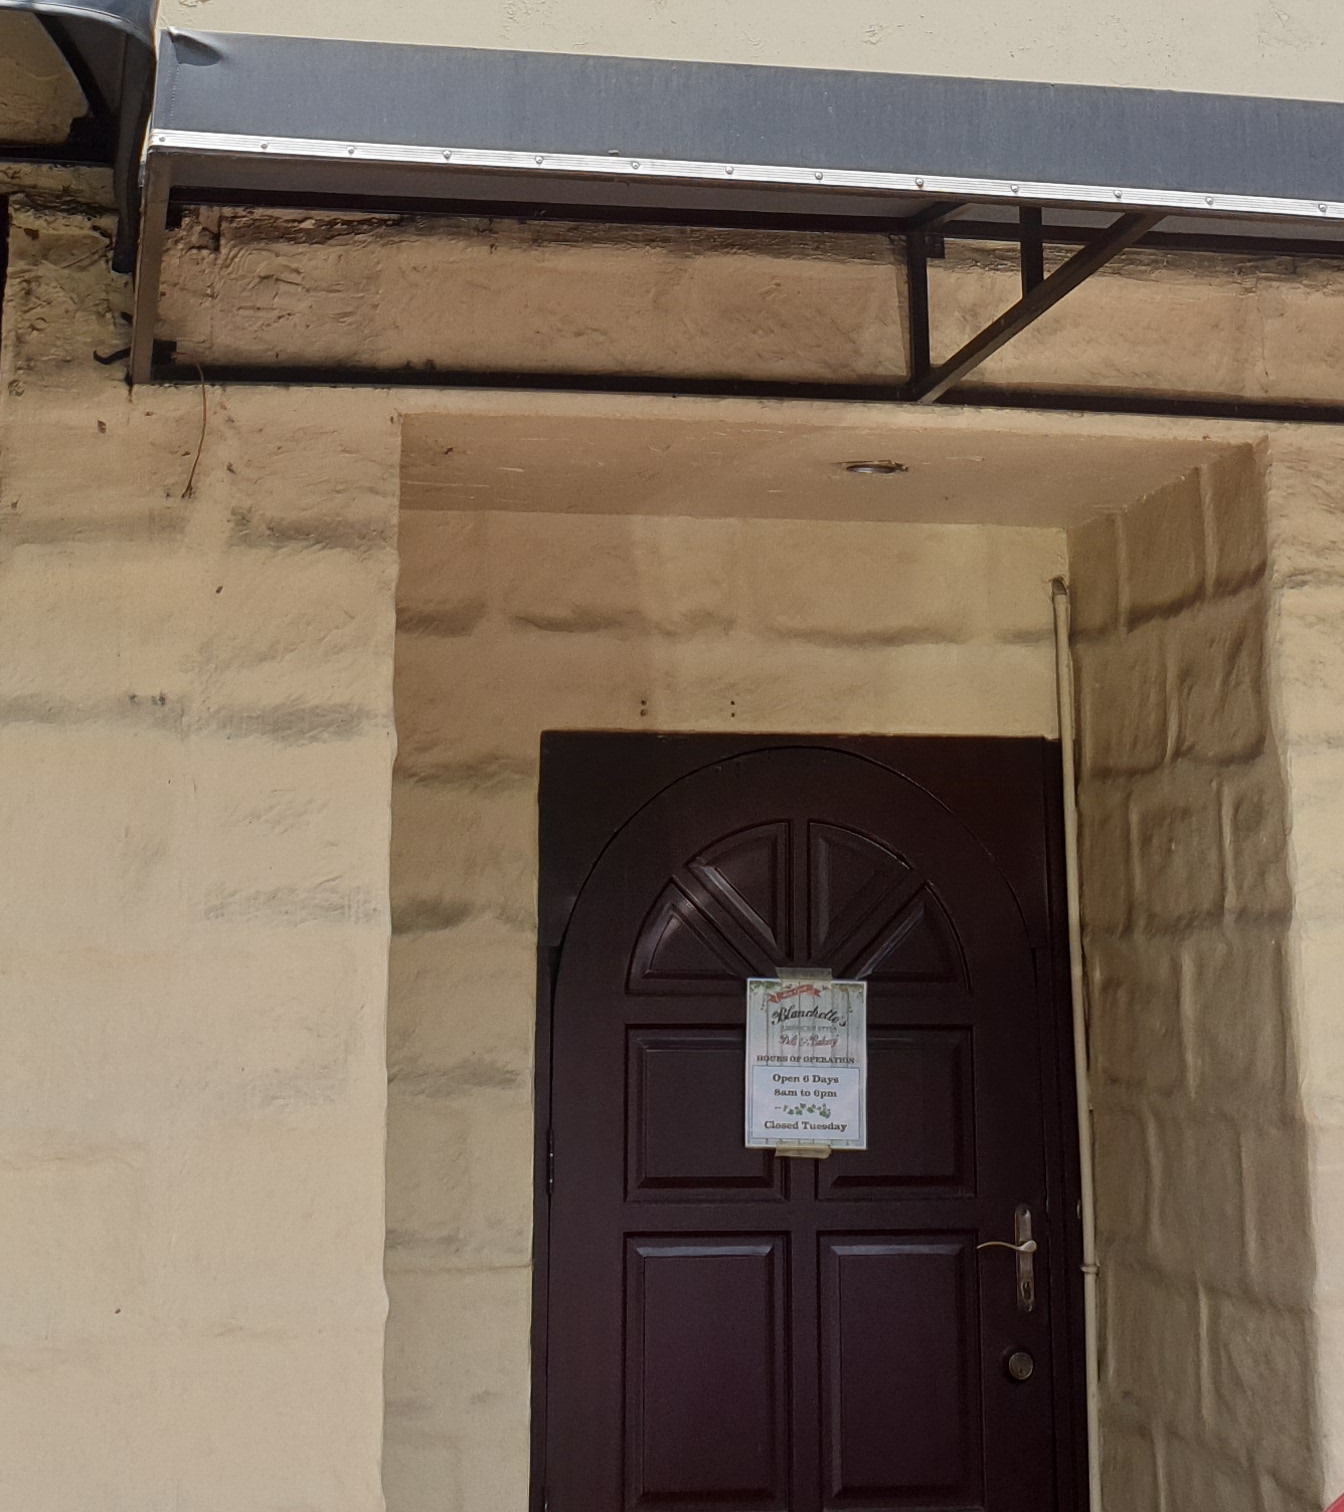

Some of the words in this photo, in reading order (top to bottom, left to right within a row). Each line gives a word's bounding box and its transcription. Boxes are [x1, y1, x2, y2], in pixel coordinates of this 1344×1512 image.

[772, 1074, 800, 1084] Open
[803, 1075, 809, 1083] 6
[812, 1074, 839, 1085] Days
[800, 1089, 811, 1097] to
[814, 1089, 837, 1099] 6pm
[764, 1121, 799, 1130] Closed
[802, 1121, 847, 1132] Tuesday
